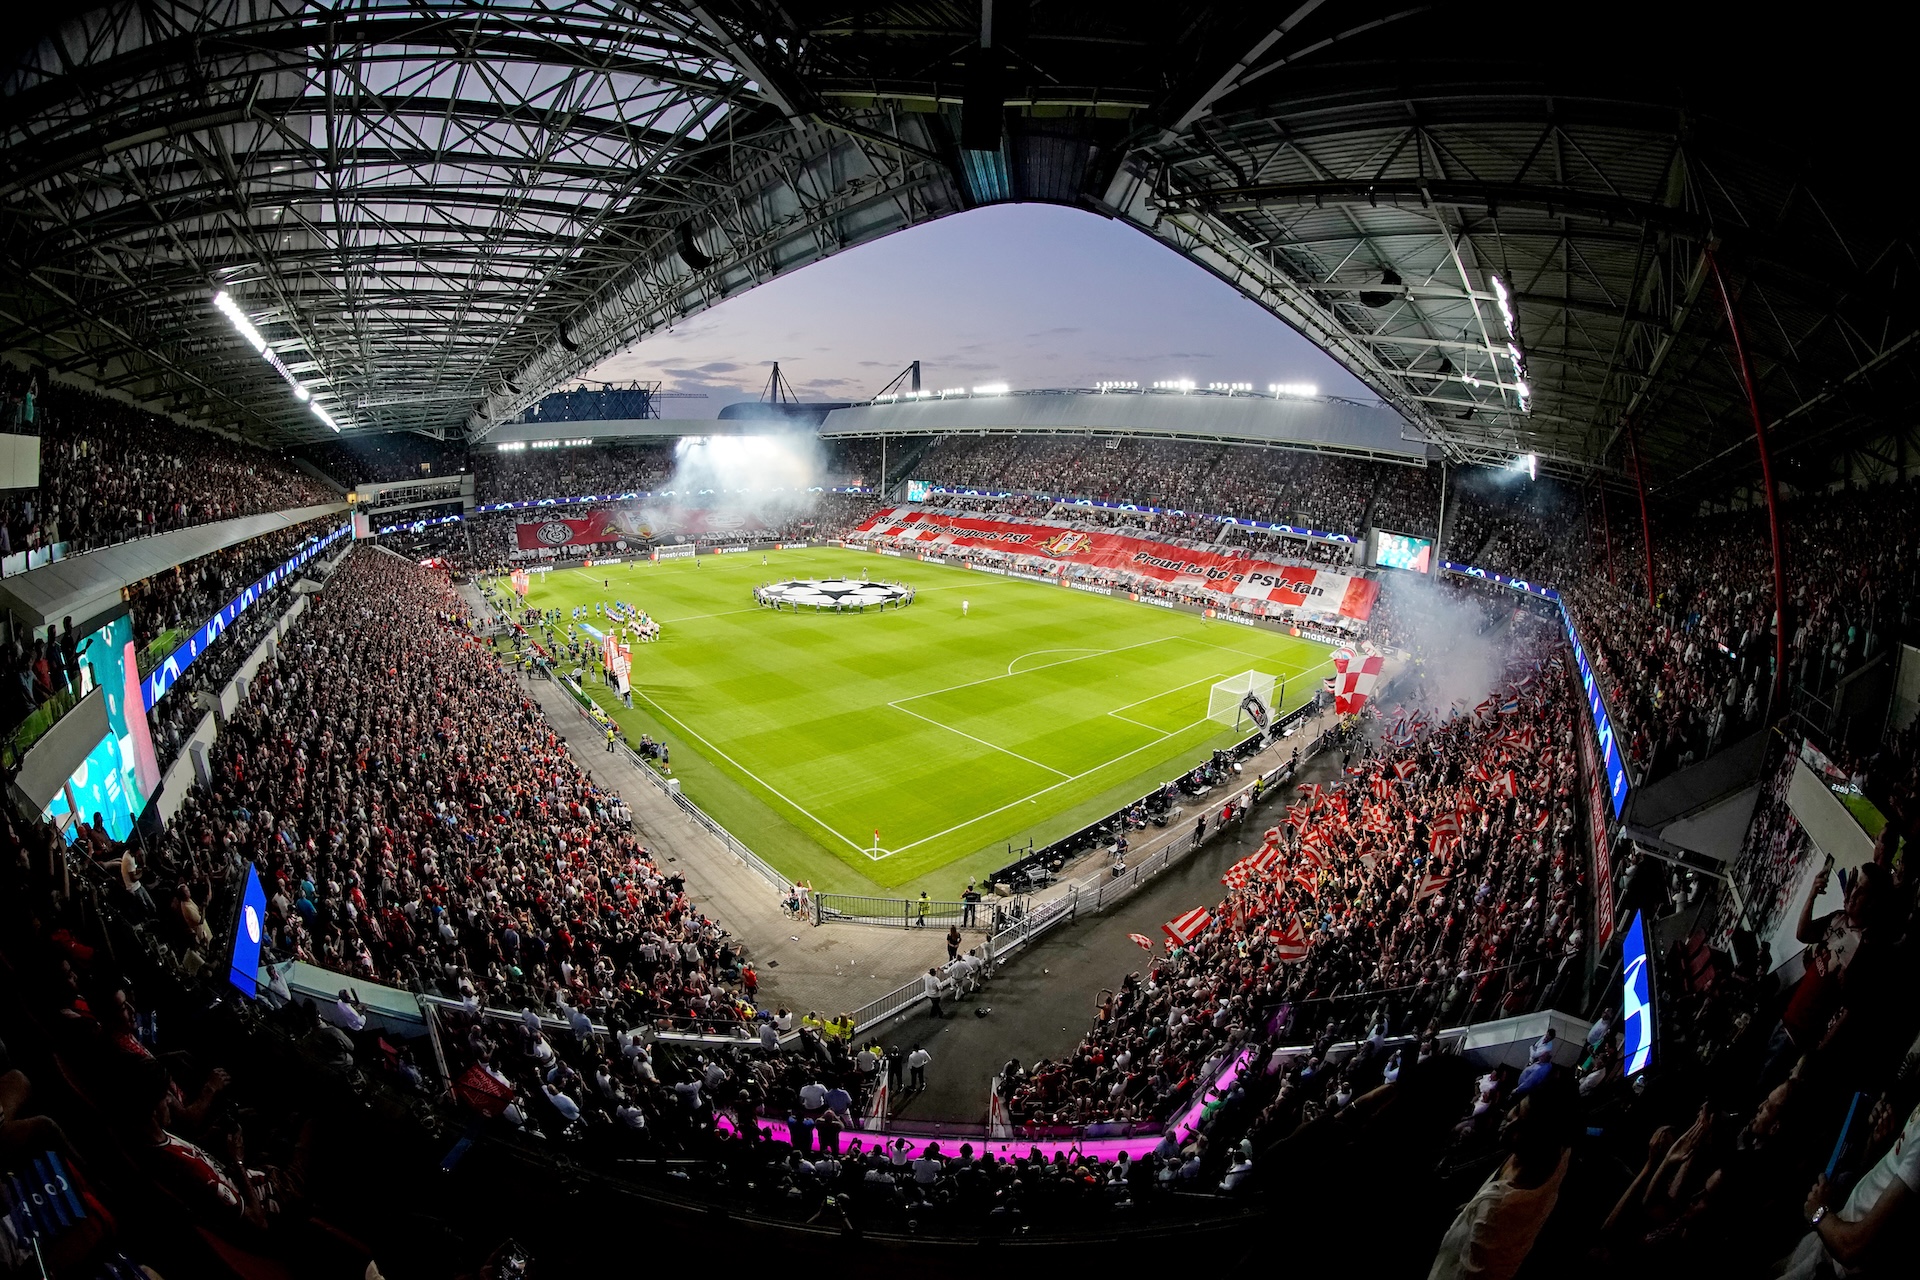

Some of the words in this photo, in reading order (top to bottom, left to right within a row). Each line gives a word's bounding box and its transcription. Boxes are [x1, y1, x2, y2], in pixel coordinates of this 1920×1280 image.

[949, 527, 1002, 541] supports
[1001, 532, 1032, 545] PSV
[783, 542, 808, 550] priceless
[593, 557, 621, 566] priceless
[924, 557, 946, 565] priceless
[524, 564, 553, 574] priceless
[972, 564, 1004, 575] mastercard
[1134, 552, 1184, 572] Proud
[1185, 563, 1203, 575] to
[1206, 566, 1229, 579] be
[1232, 574, 1245, 584] a
[1248, 573, 1325, 597] PSV-fan
[1071, 582, 1112, 596] mastercard
[1140, 596, 1173, 609] priceless
[1217, 612, 1254, 627] priceless
[1302, 631, 1356, 648] masterca
